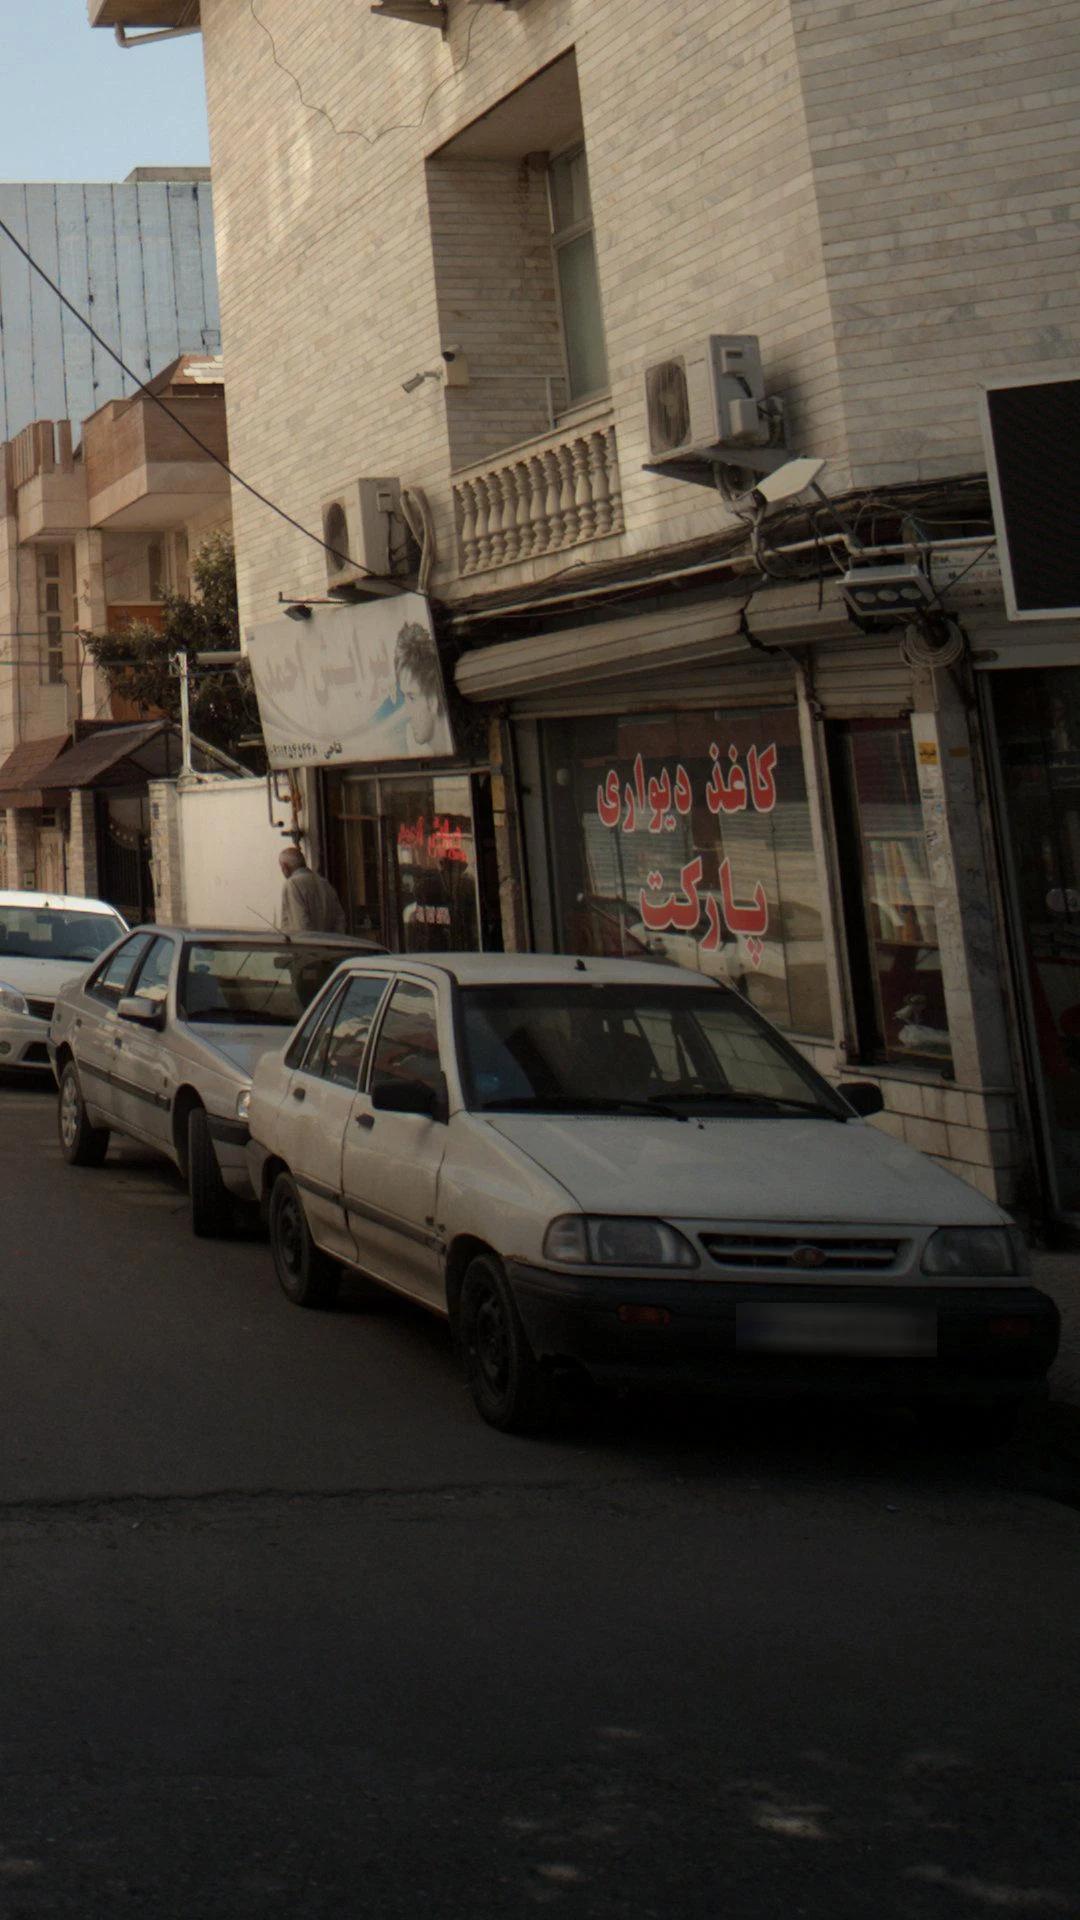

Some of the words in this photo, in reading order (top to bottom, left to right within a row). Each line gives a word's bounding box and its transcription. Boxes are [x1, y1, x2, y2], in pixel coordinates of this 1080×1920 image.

[597, 752, 693, 833] دیواری
[706, 742, 777, 813] کاغذ
[639, 855, 769, 969] پارکت
